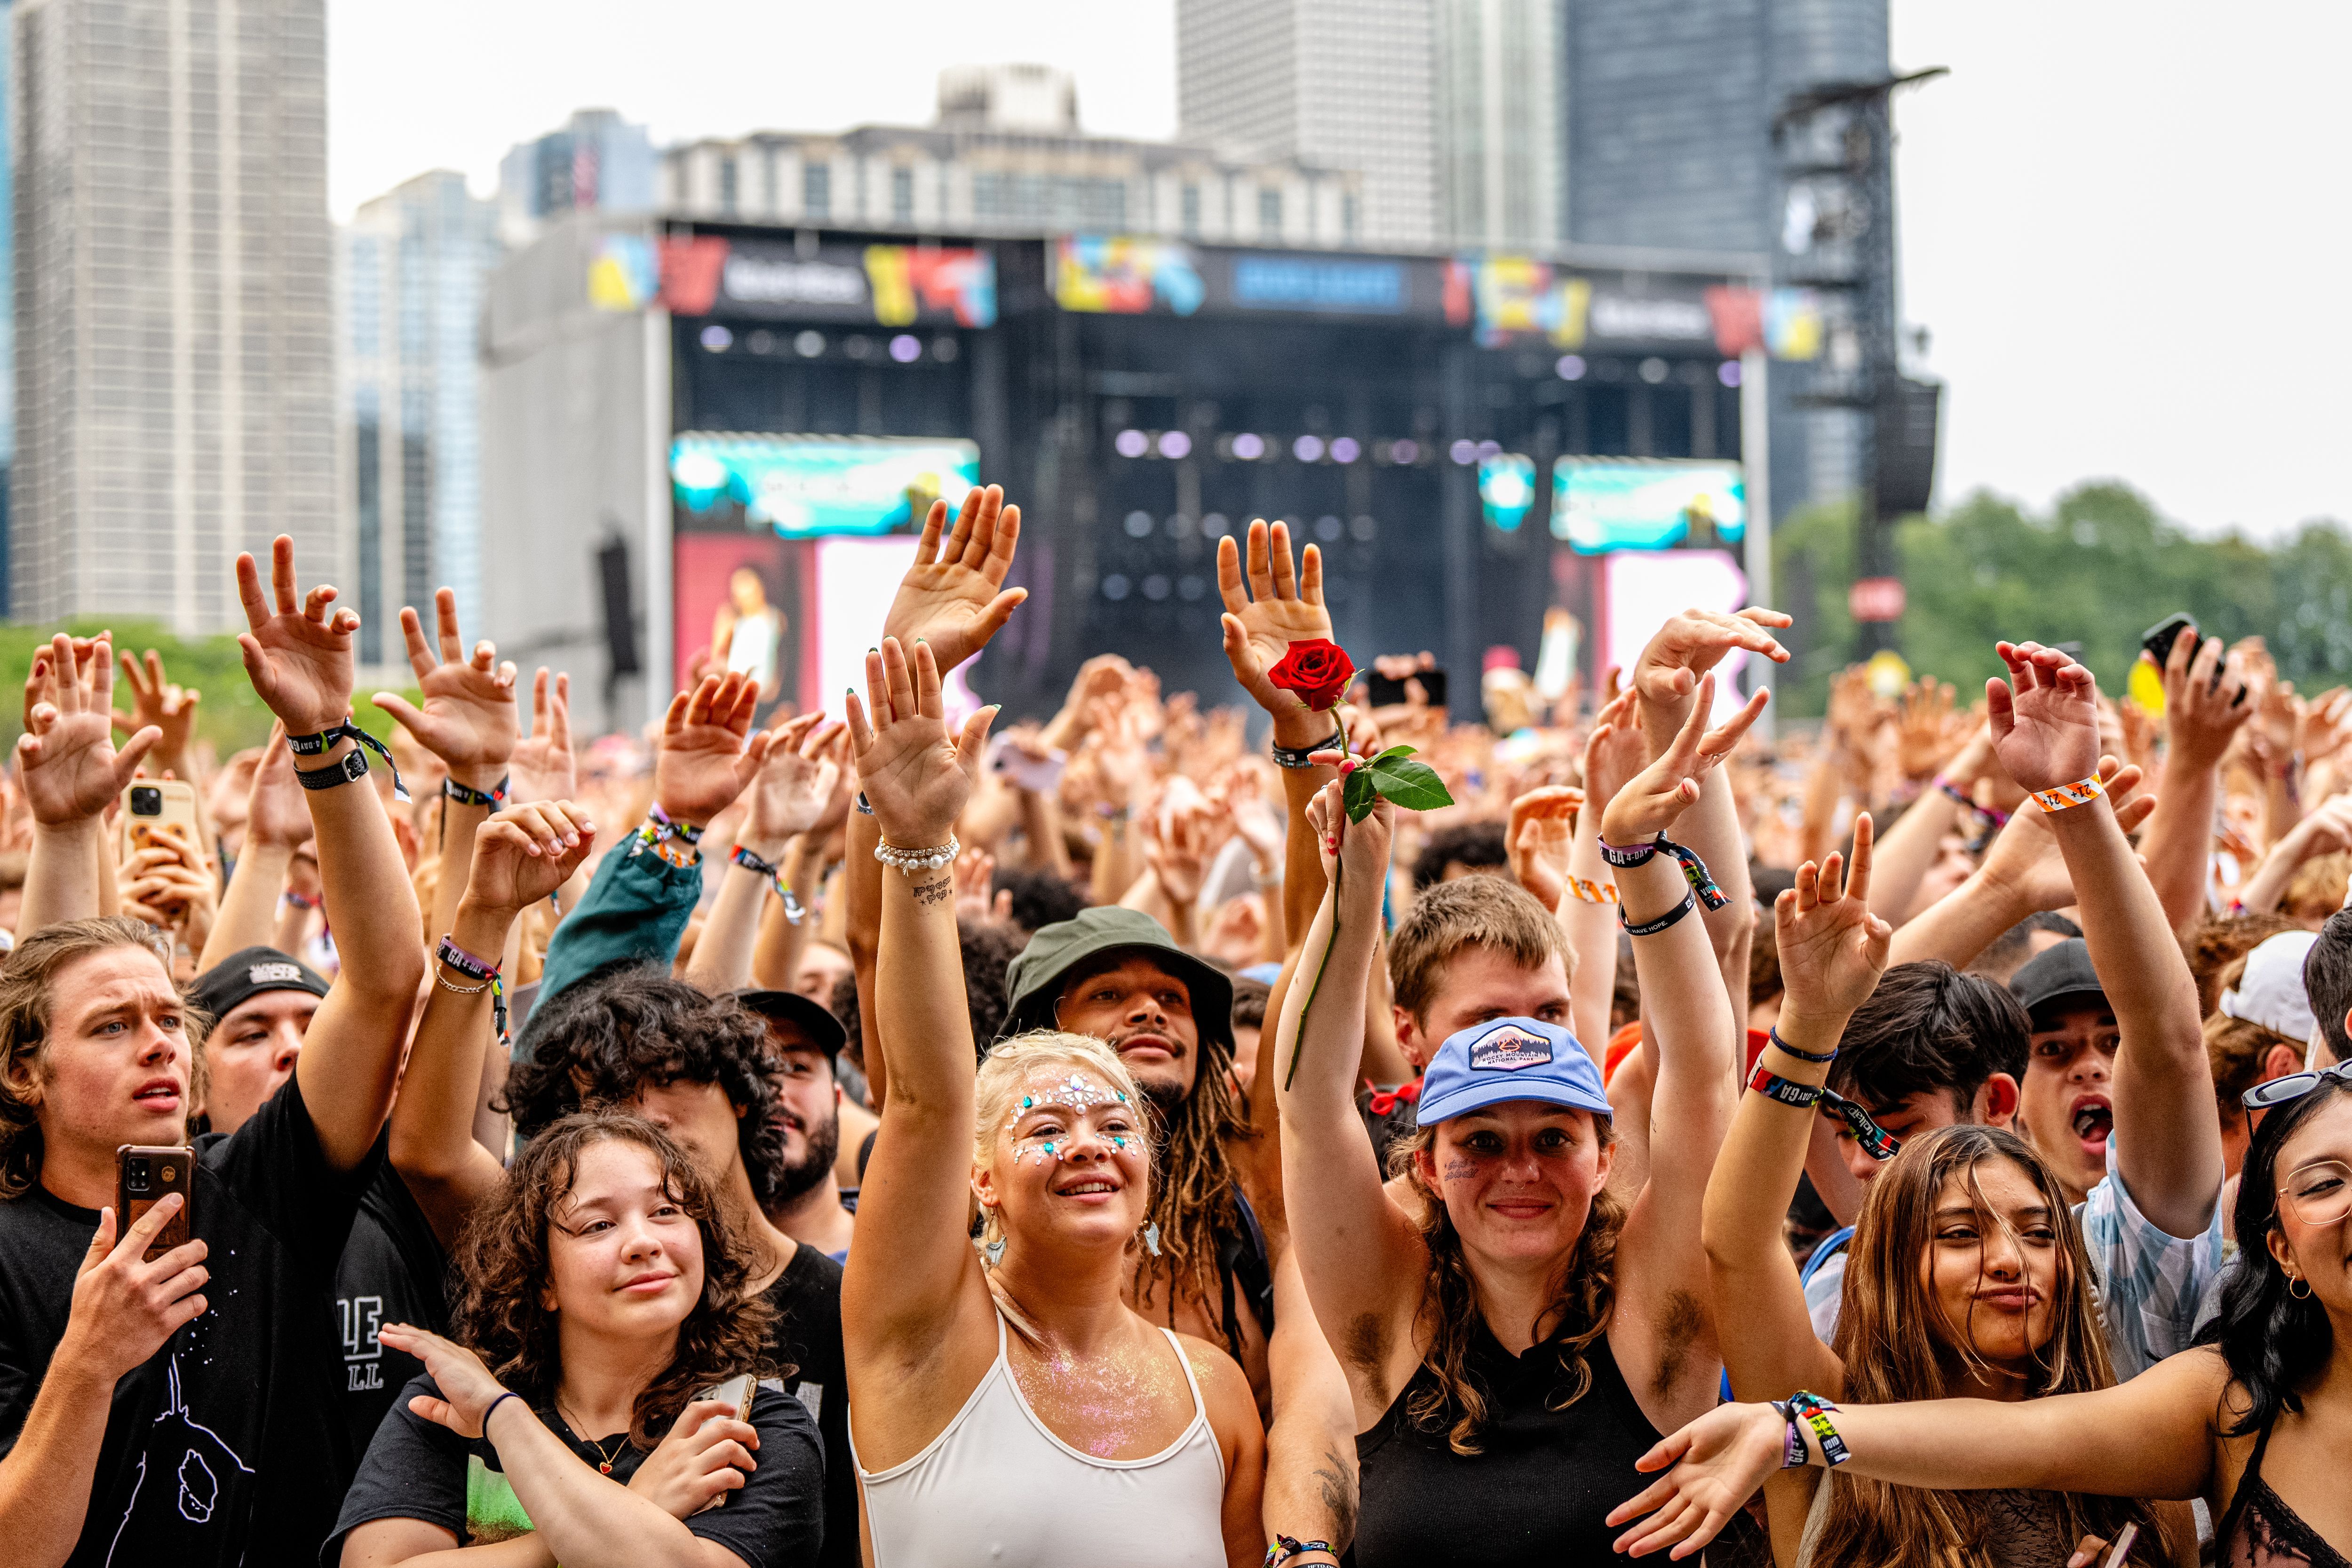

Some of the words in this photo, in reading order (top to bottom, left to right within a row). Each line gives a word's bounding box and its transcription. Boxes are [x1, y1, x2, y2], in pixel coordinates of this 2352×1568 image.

[301, 740, 320, 750] 4-DAY
[2071, 783, 2091, 797] 21+
[2043, 793, 2060, 806] 21+
[1609, 849, 1625, 864] GA
[1626, 848, 1648, 861] 4-DAY
[1648, 920, 1668, 931] HOPE.
[447, 948, 464, 967] GA
[462, 960, 482, 974] 4-DAY
[1483, 1054, 1503, 1062] ROCKY
[1780, 1084, 1800, 1102] GA
[1823, 1436, 1840, 1450] VOID
[1789, 1449, 1804, 1463] GA
